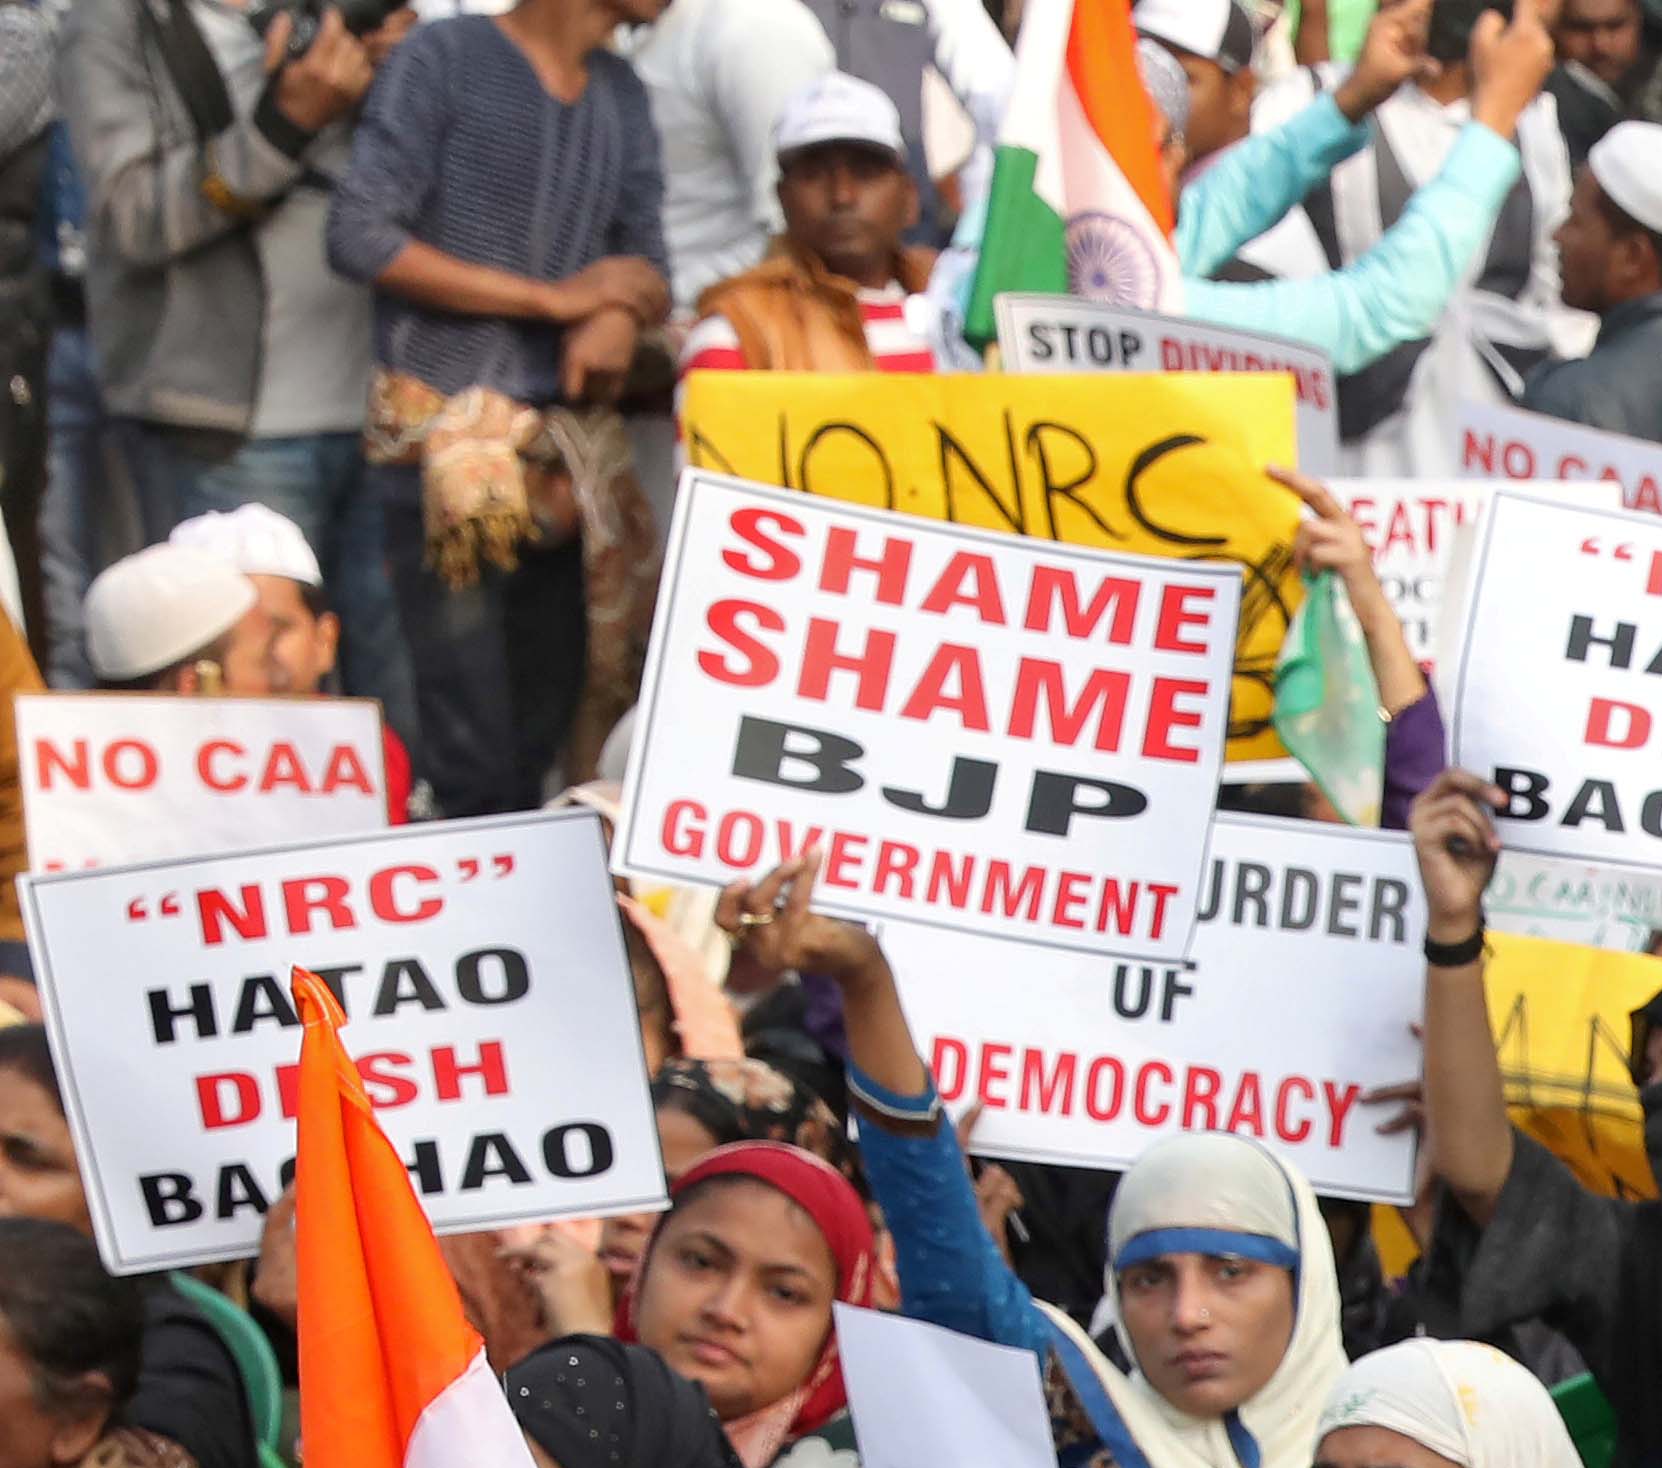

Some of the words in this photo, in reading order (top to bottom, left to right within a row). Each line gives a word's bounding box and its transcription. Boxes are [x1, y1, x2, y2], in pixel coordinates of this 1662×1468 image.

[1029, 322, 1143, 369] STOP
[933, 410, 1228, 546] NRC
[1463, 428, 1538, 480] NO
[719, 507, 1217, 656] SHAME
[696, 598, 1210, 763] SHAME
[34, 736, 161, 793] NO
[194, 738, 375, 797] CAA
[729, 714, 1150, 837] BJP
[661, 797, 1181, 941] GOVERNMENT
[1112, 961, 1198, 1022] OF
[930, 1036, 1361, 1150] DEMOCRACY
